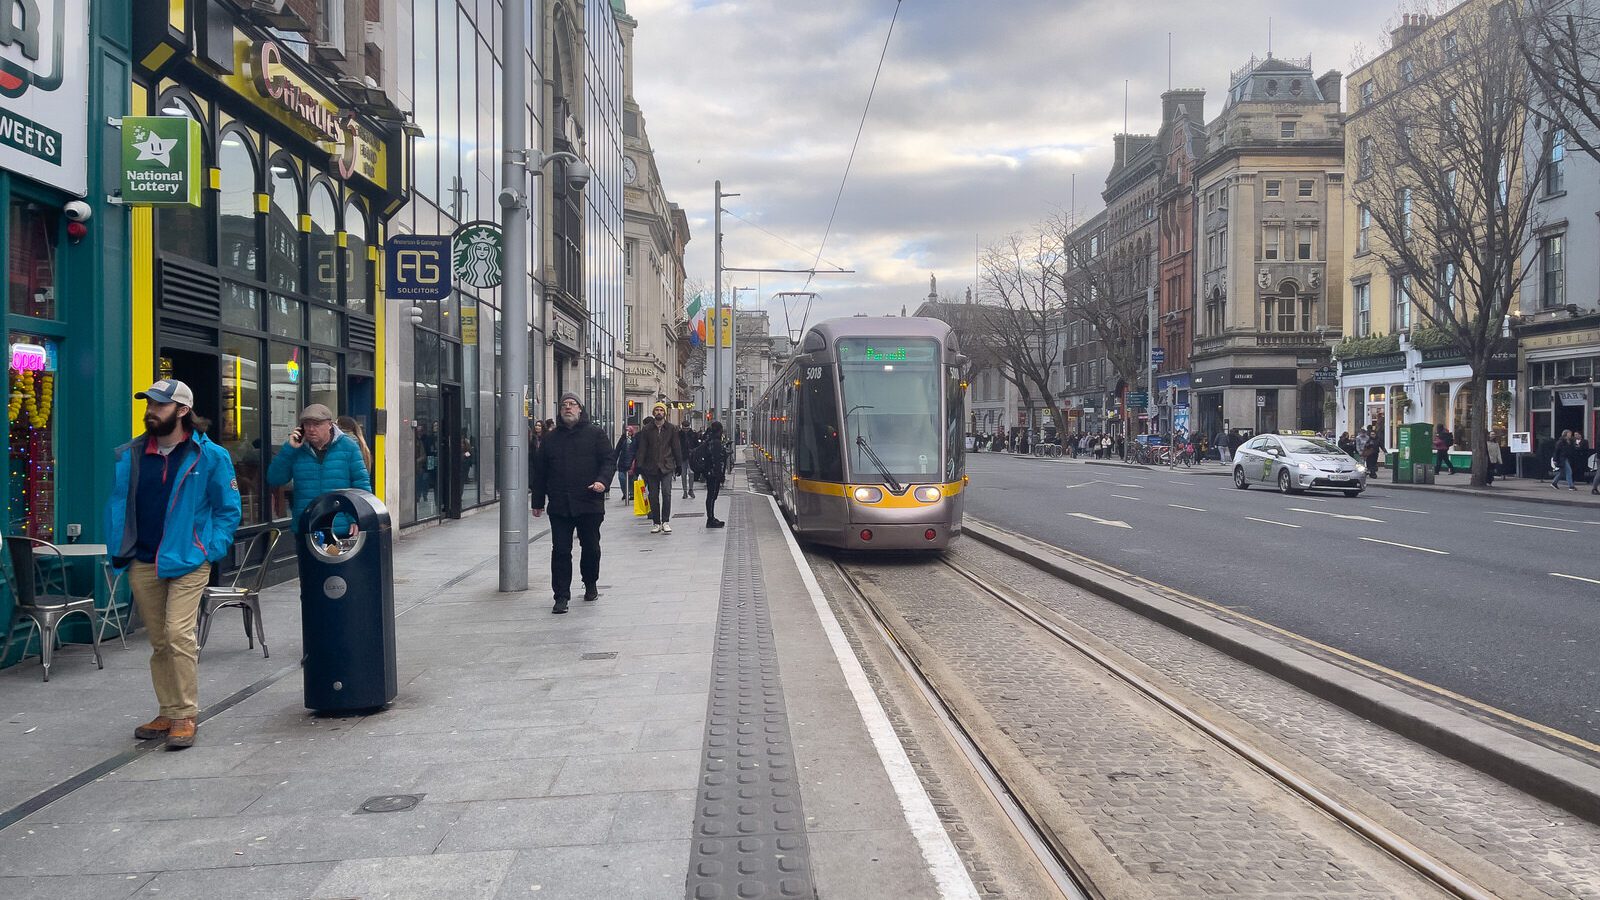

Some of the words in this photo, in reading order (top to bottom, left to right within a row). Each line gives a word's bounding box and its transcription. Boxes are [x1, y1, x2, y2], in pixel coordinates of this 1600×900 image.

[126, 170, 183, 181] National
[130, 181, 179, 195] Lottery
[397, 287, 440, 295] SOLICITORS
[710, 317, 729, 327] YS
[13, 350, 45, 375] open
[806, 366, 822, 380] 5018
